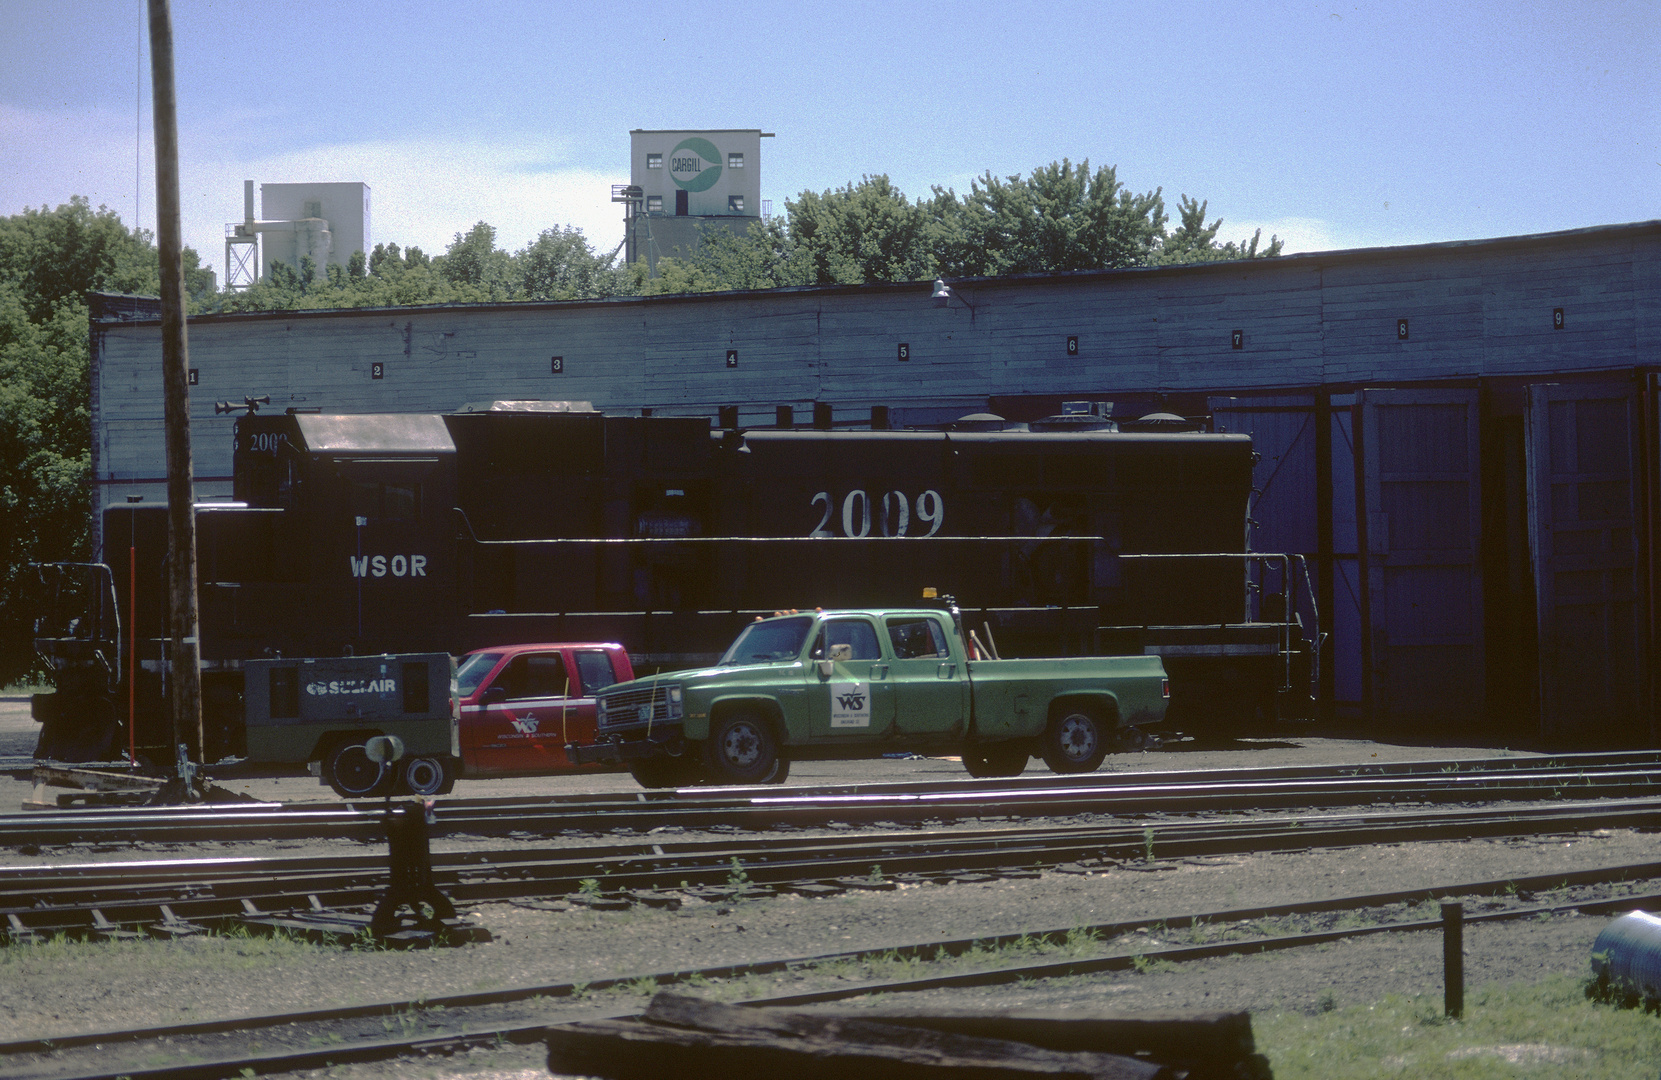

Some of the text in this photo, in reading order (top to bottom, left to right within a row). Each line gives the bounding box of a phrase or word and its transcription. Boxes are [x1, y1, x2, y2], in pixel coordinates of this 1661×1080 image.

[672, 158, 701, 172] CARGILL
[1555, 312, 1562, 325] 9
[1400, 323, 1406, 336] 8
[1069, 339, 1076, 351] 6
[1234, 334, 1241, 345] 7
[900, 346, 907, 357] 5
[553, 359, 561, 370] 3
[728, 354, 736, 364] 4
[373, 365, 381, 376] 2
[809, 489, 944, 537] 2009
[350, 555, 427, 577] WSOR
